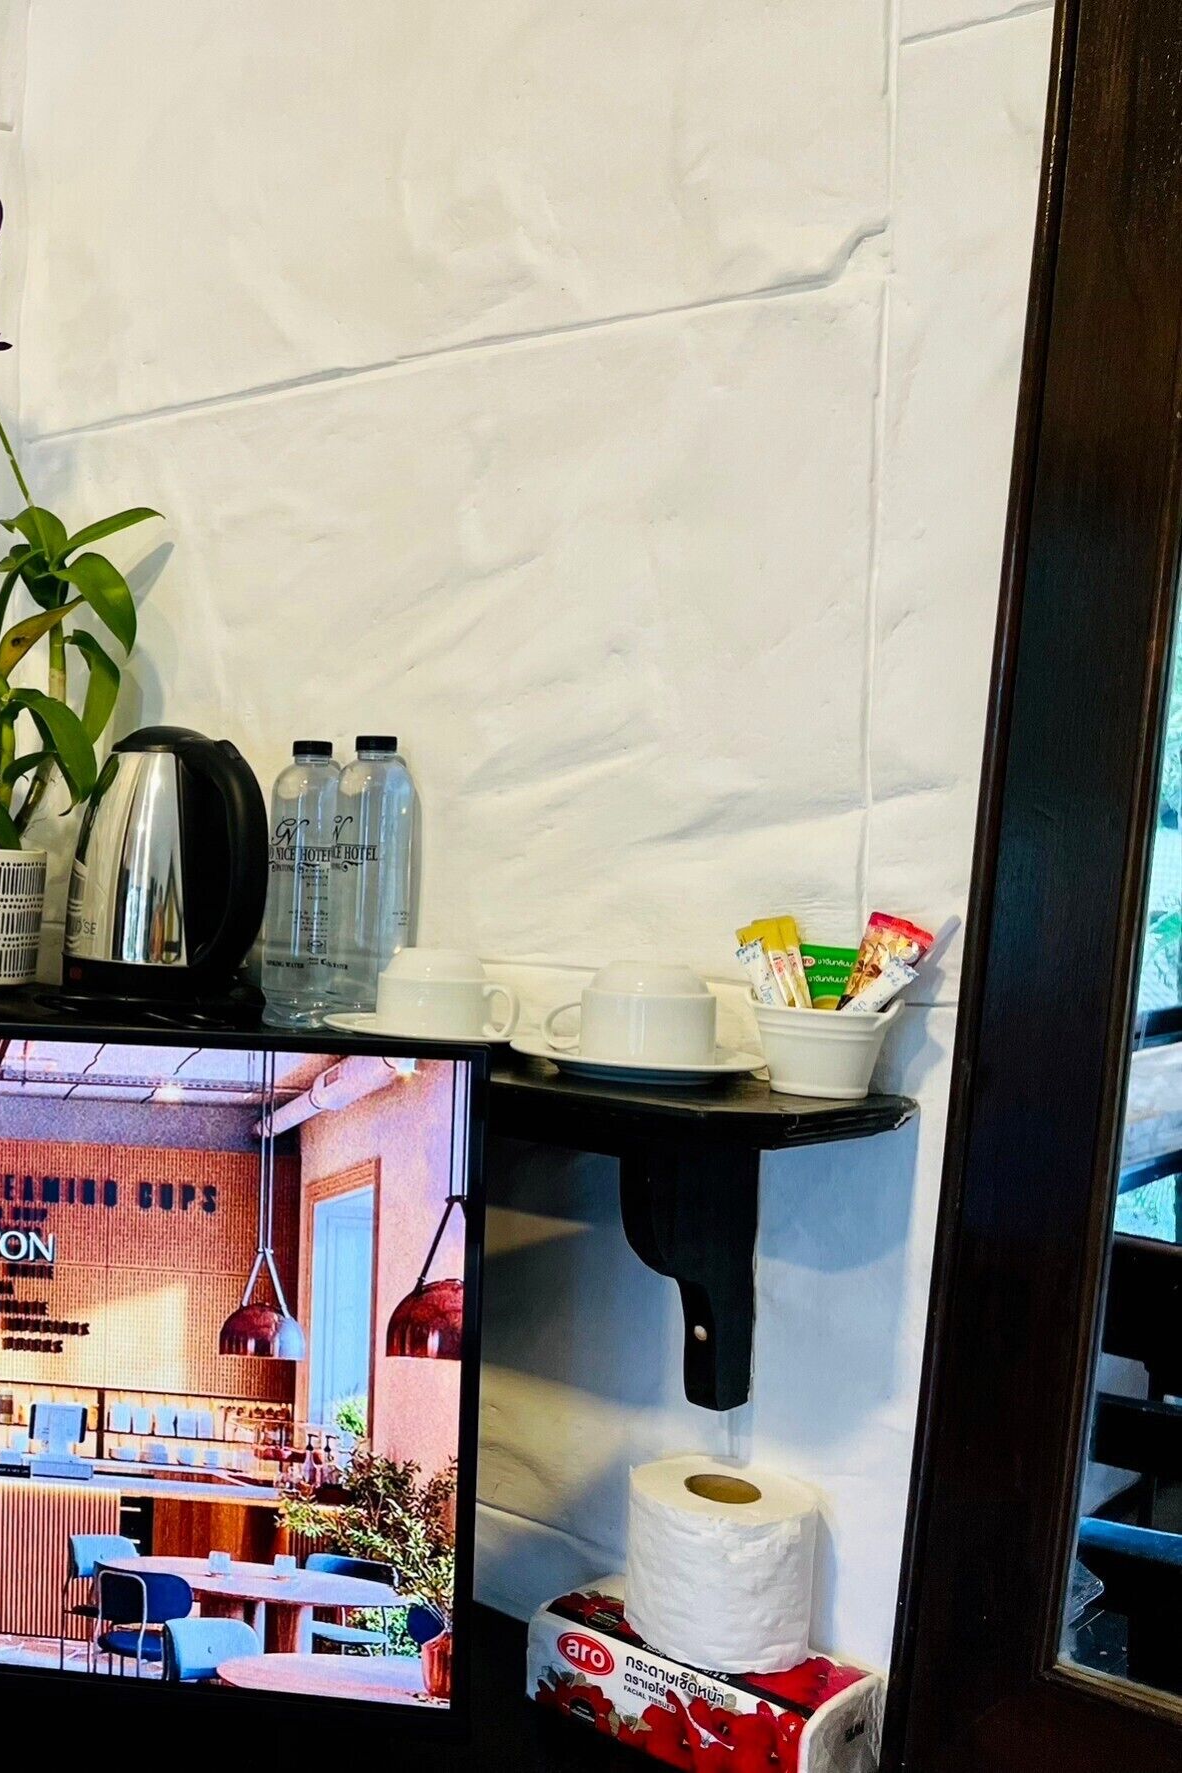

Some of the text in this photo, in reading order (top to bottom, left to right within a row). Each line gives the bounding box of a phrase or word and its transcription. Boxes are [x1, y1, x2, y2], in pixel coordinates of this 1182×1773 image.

[276, 847, 295, 861] NICE
[344, 846, 378, 861] HOTEL
[137, 1182, 217, 1213] CUPS
[566, 1638, 605, 1668] aro
[626, 1655, 725, 1706] กระดาษเช็ดหน้า
[623, 1684, 676, 1713] FACIAL TISSUES
